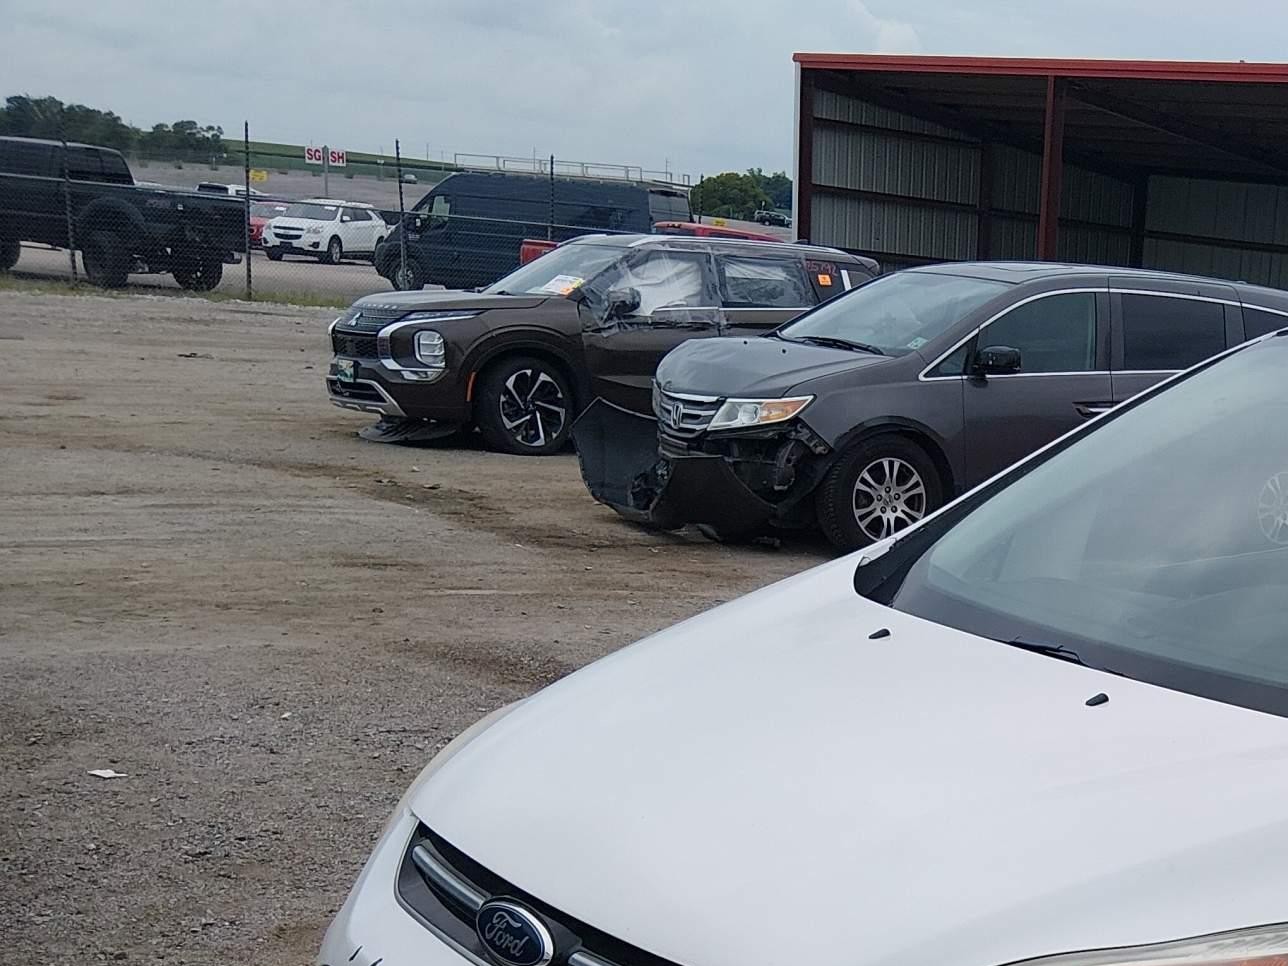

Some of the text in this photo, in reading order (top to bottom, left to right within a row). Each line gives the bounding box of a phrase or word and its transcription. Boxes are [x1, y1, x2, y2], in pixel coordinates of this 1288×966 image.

[306, 148, 322, 161] SG
[330, 150, 345, 165] SH
[484, 910, 530, 958] Ford
